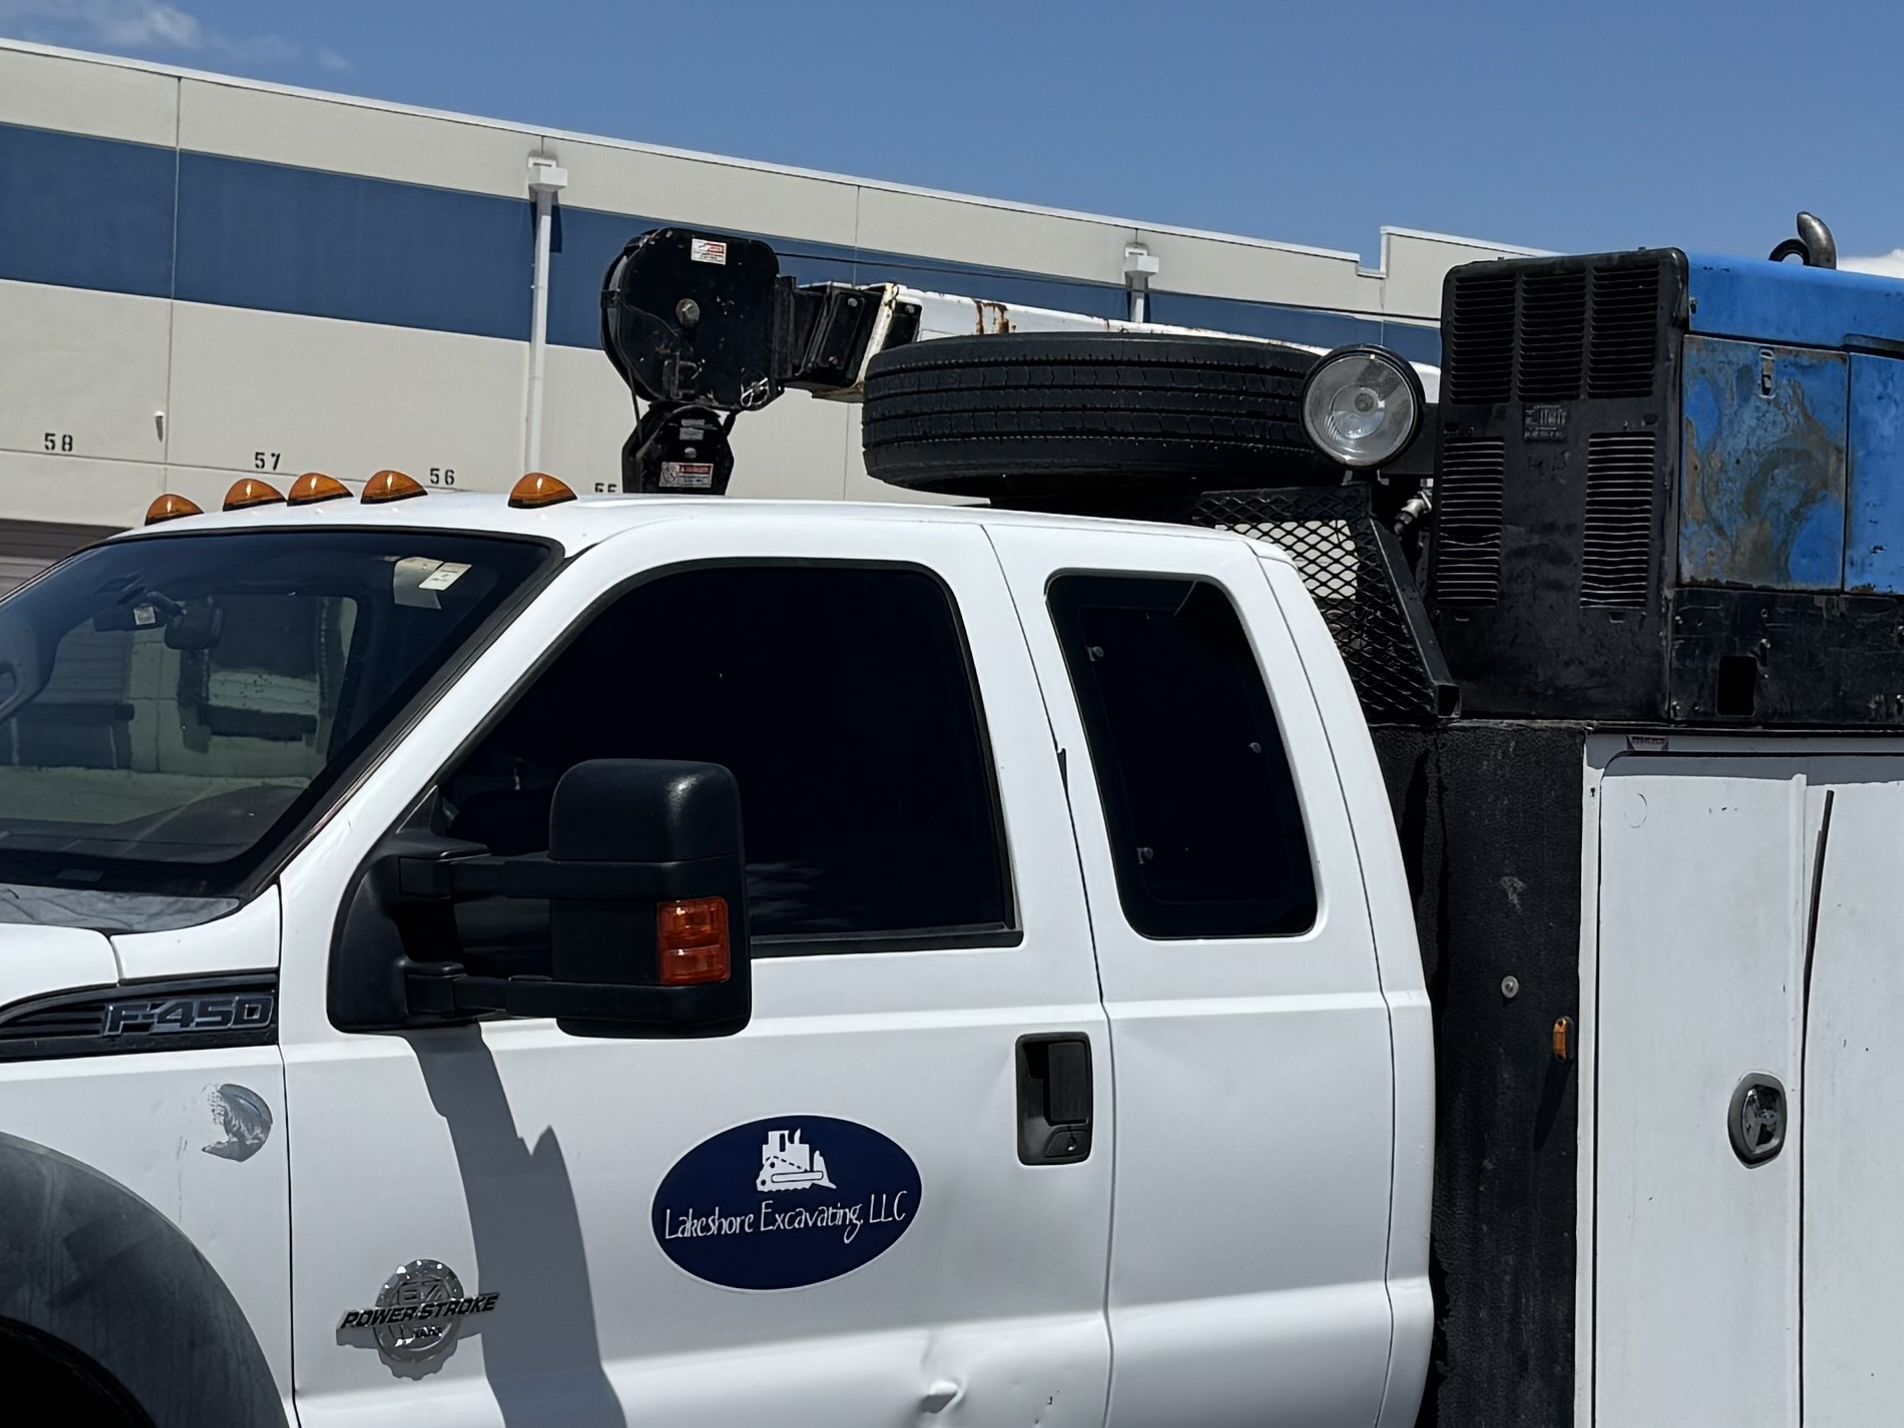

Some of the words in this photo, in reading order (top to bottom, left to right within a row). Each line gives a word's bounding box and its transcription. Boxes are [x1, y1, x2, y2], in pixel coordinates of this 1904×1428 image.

[44, 432, 74, 452] 58
[254, 451, 281, 471] 57
[429, 467, 456, 485] 56
[103, 995, 274, 1036] F-450
[665, 1206, 754, 1239] Lakeshore
[869, 1190, 908, 1224] LLC
[340, 1305, 419, 1329] POWER
[417, 1292, 500, 1320] STROKE
